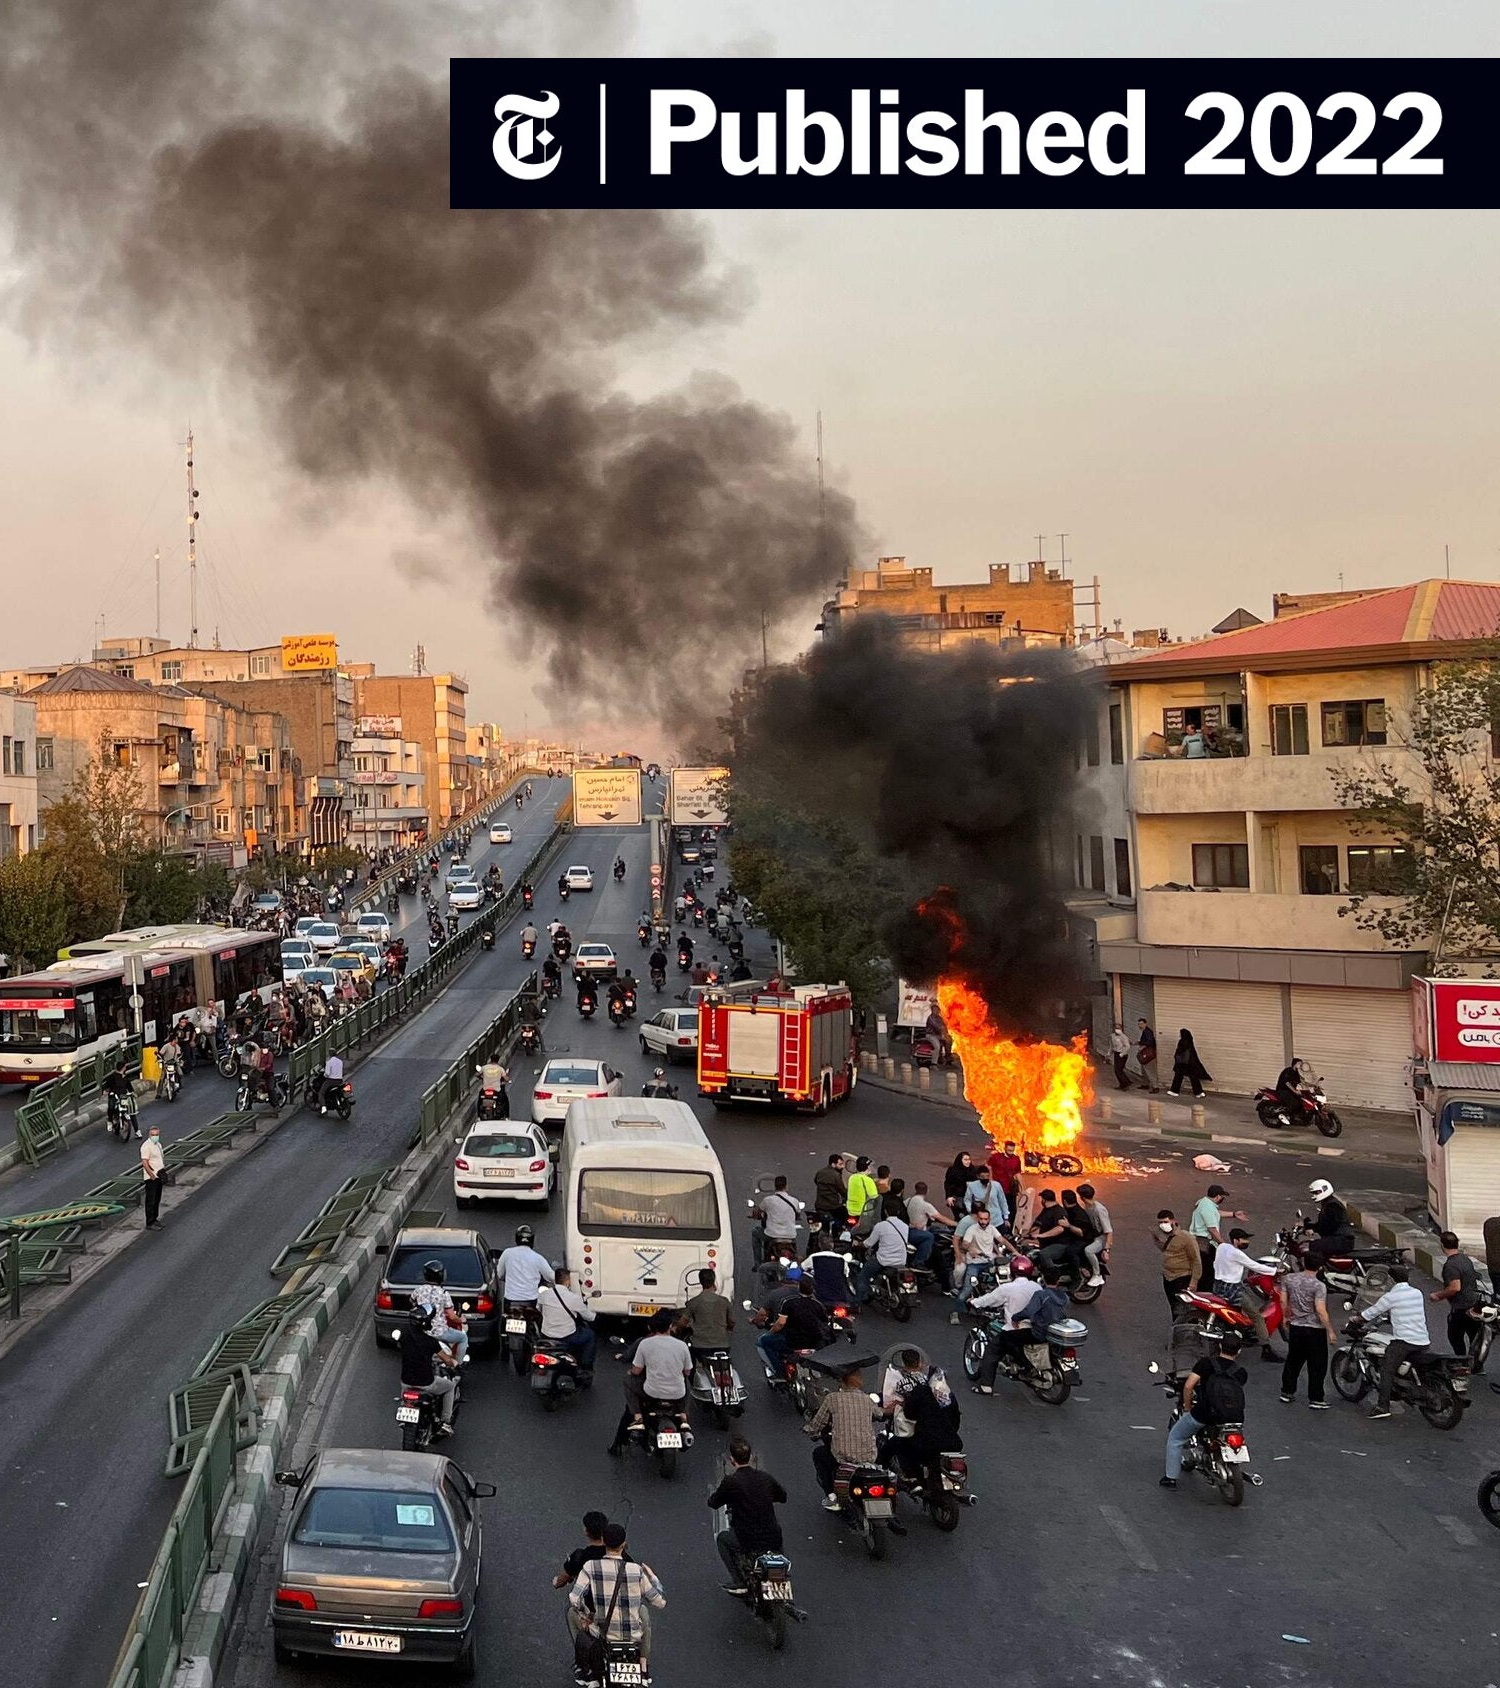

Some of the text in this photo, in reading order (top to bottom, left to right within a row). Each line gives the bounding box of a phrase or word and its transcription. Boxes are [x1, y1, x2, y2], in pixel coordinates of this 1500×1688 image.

[287, 652, 330, 666] رزمندگان
[609, 776, 625, 785] امام
[588, 786, 625, 794] تهرانپارس
